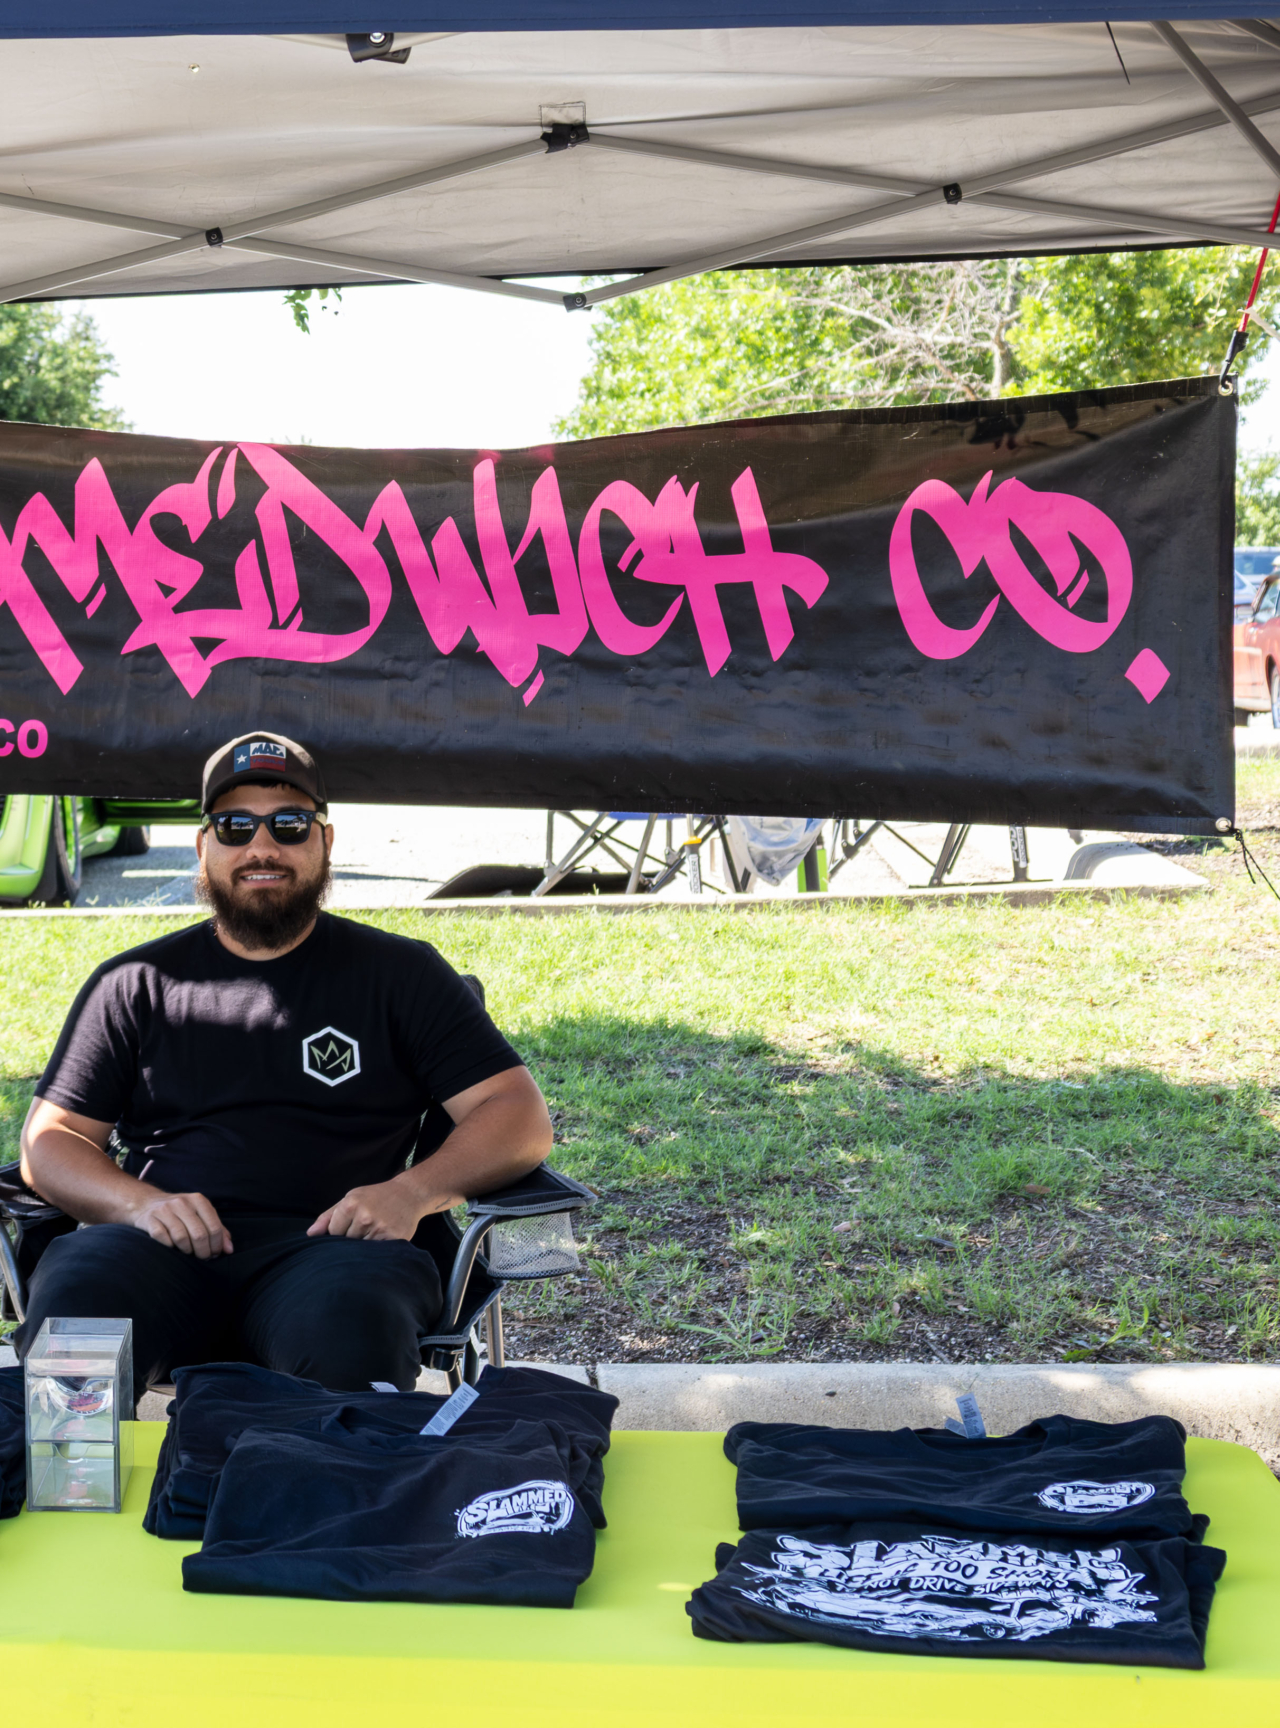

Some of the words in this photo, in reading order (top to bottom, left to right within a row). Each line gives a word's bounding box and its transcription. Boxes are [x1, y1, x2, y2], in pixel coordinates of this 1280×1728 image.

[464, 1489, 568, 1524] SLAMMED
[930, 1560, 979, 1580] TOO
[908, 1576, 969, 1593] DRIVE
